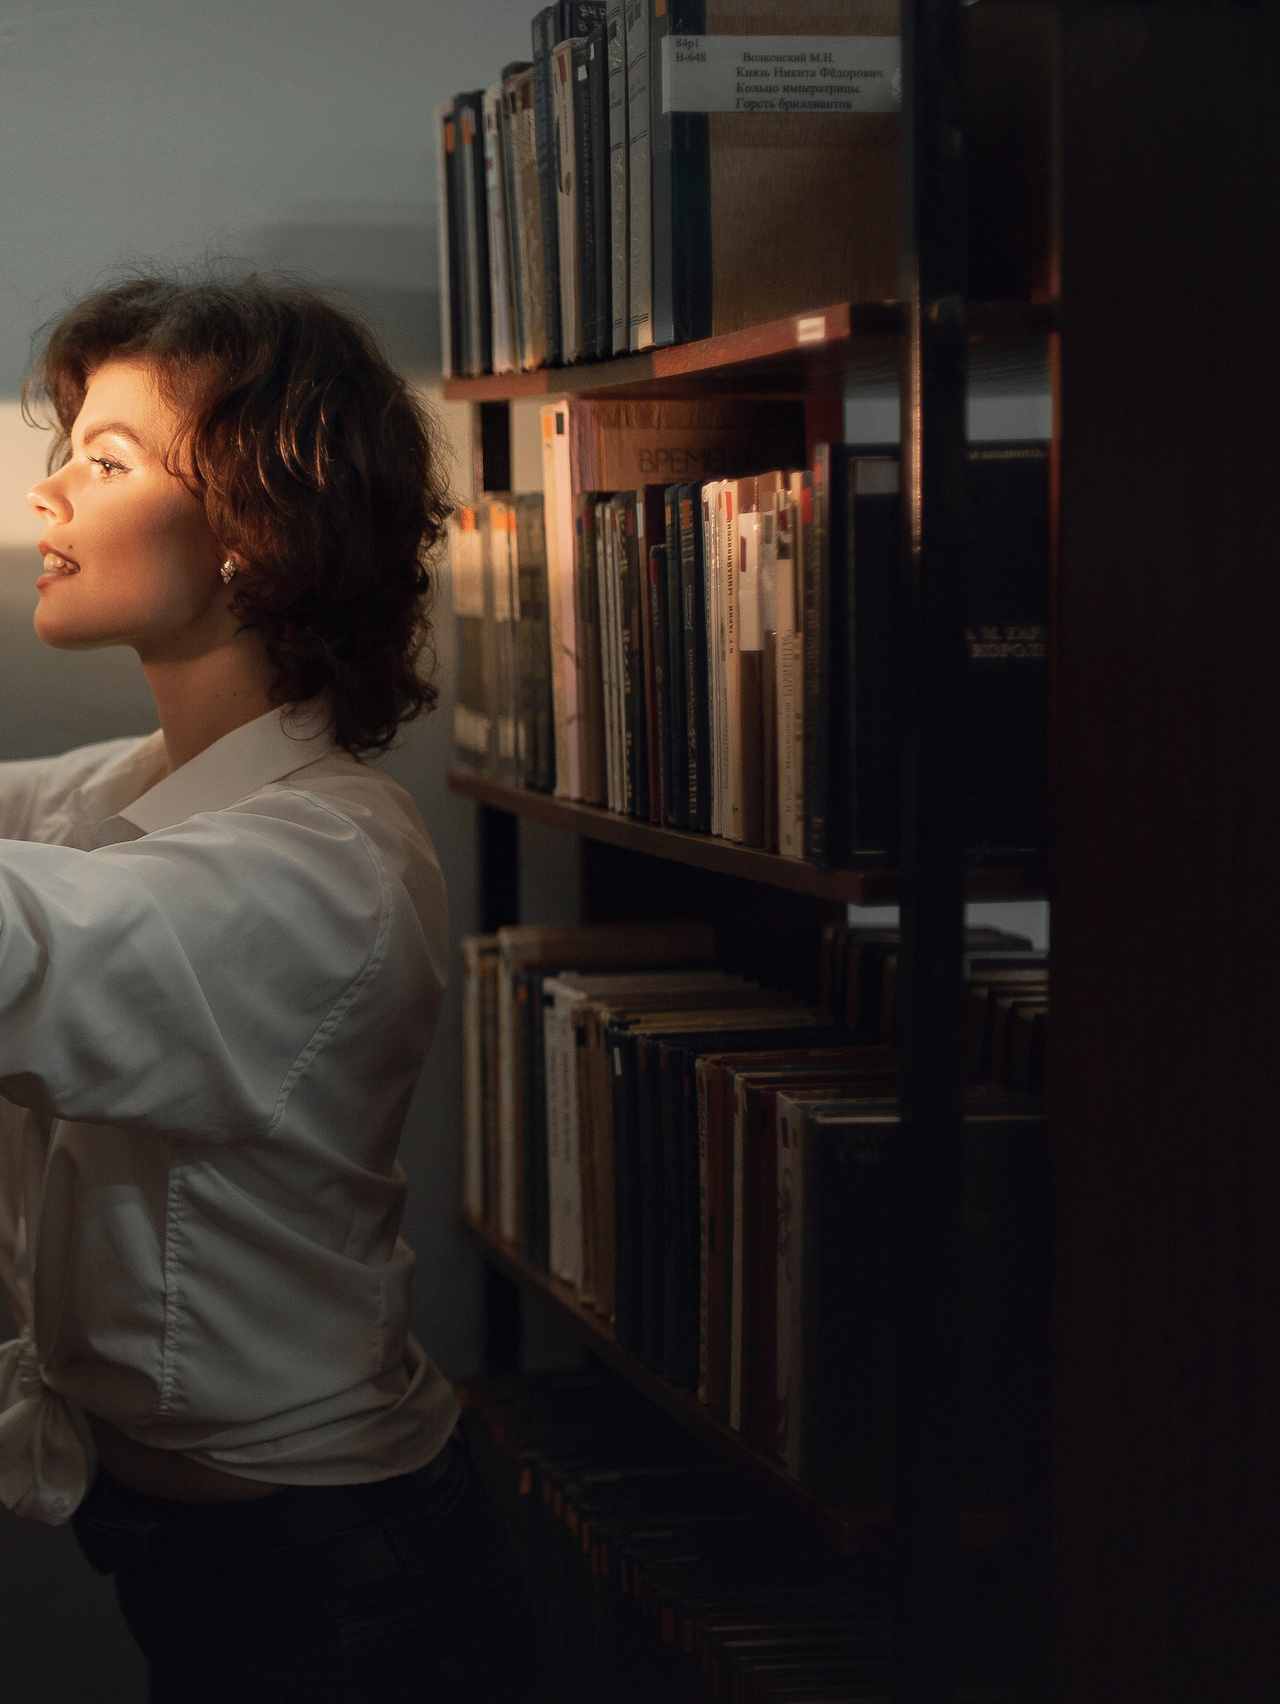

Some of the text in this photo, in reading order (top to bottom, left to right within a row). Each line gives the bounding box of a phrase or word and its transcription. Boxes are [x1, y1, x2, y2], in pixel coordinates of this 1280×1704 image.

[742, 52, 835, 63] Волконский М.Н.
[736, 67, 770, 78] Князь
[774, 67, 816, 78] Никита
[736, 82, 779, 95] Кольцо
[736, 97, 852, 111] Горсть бриллиантов
